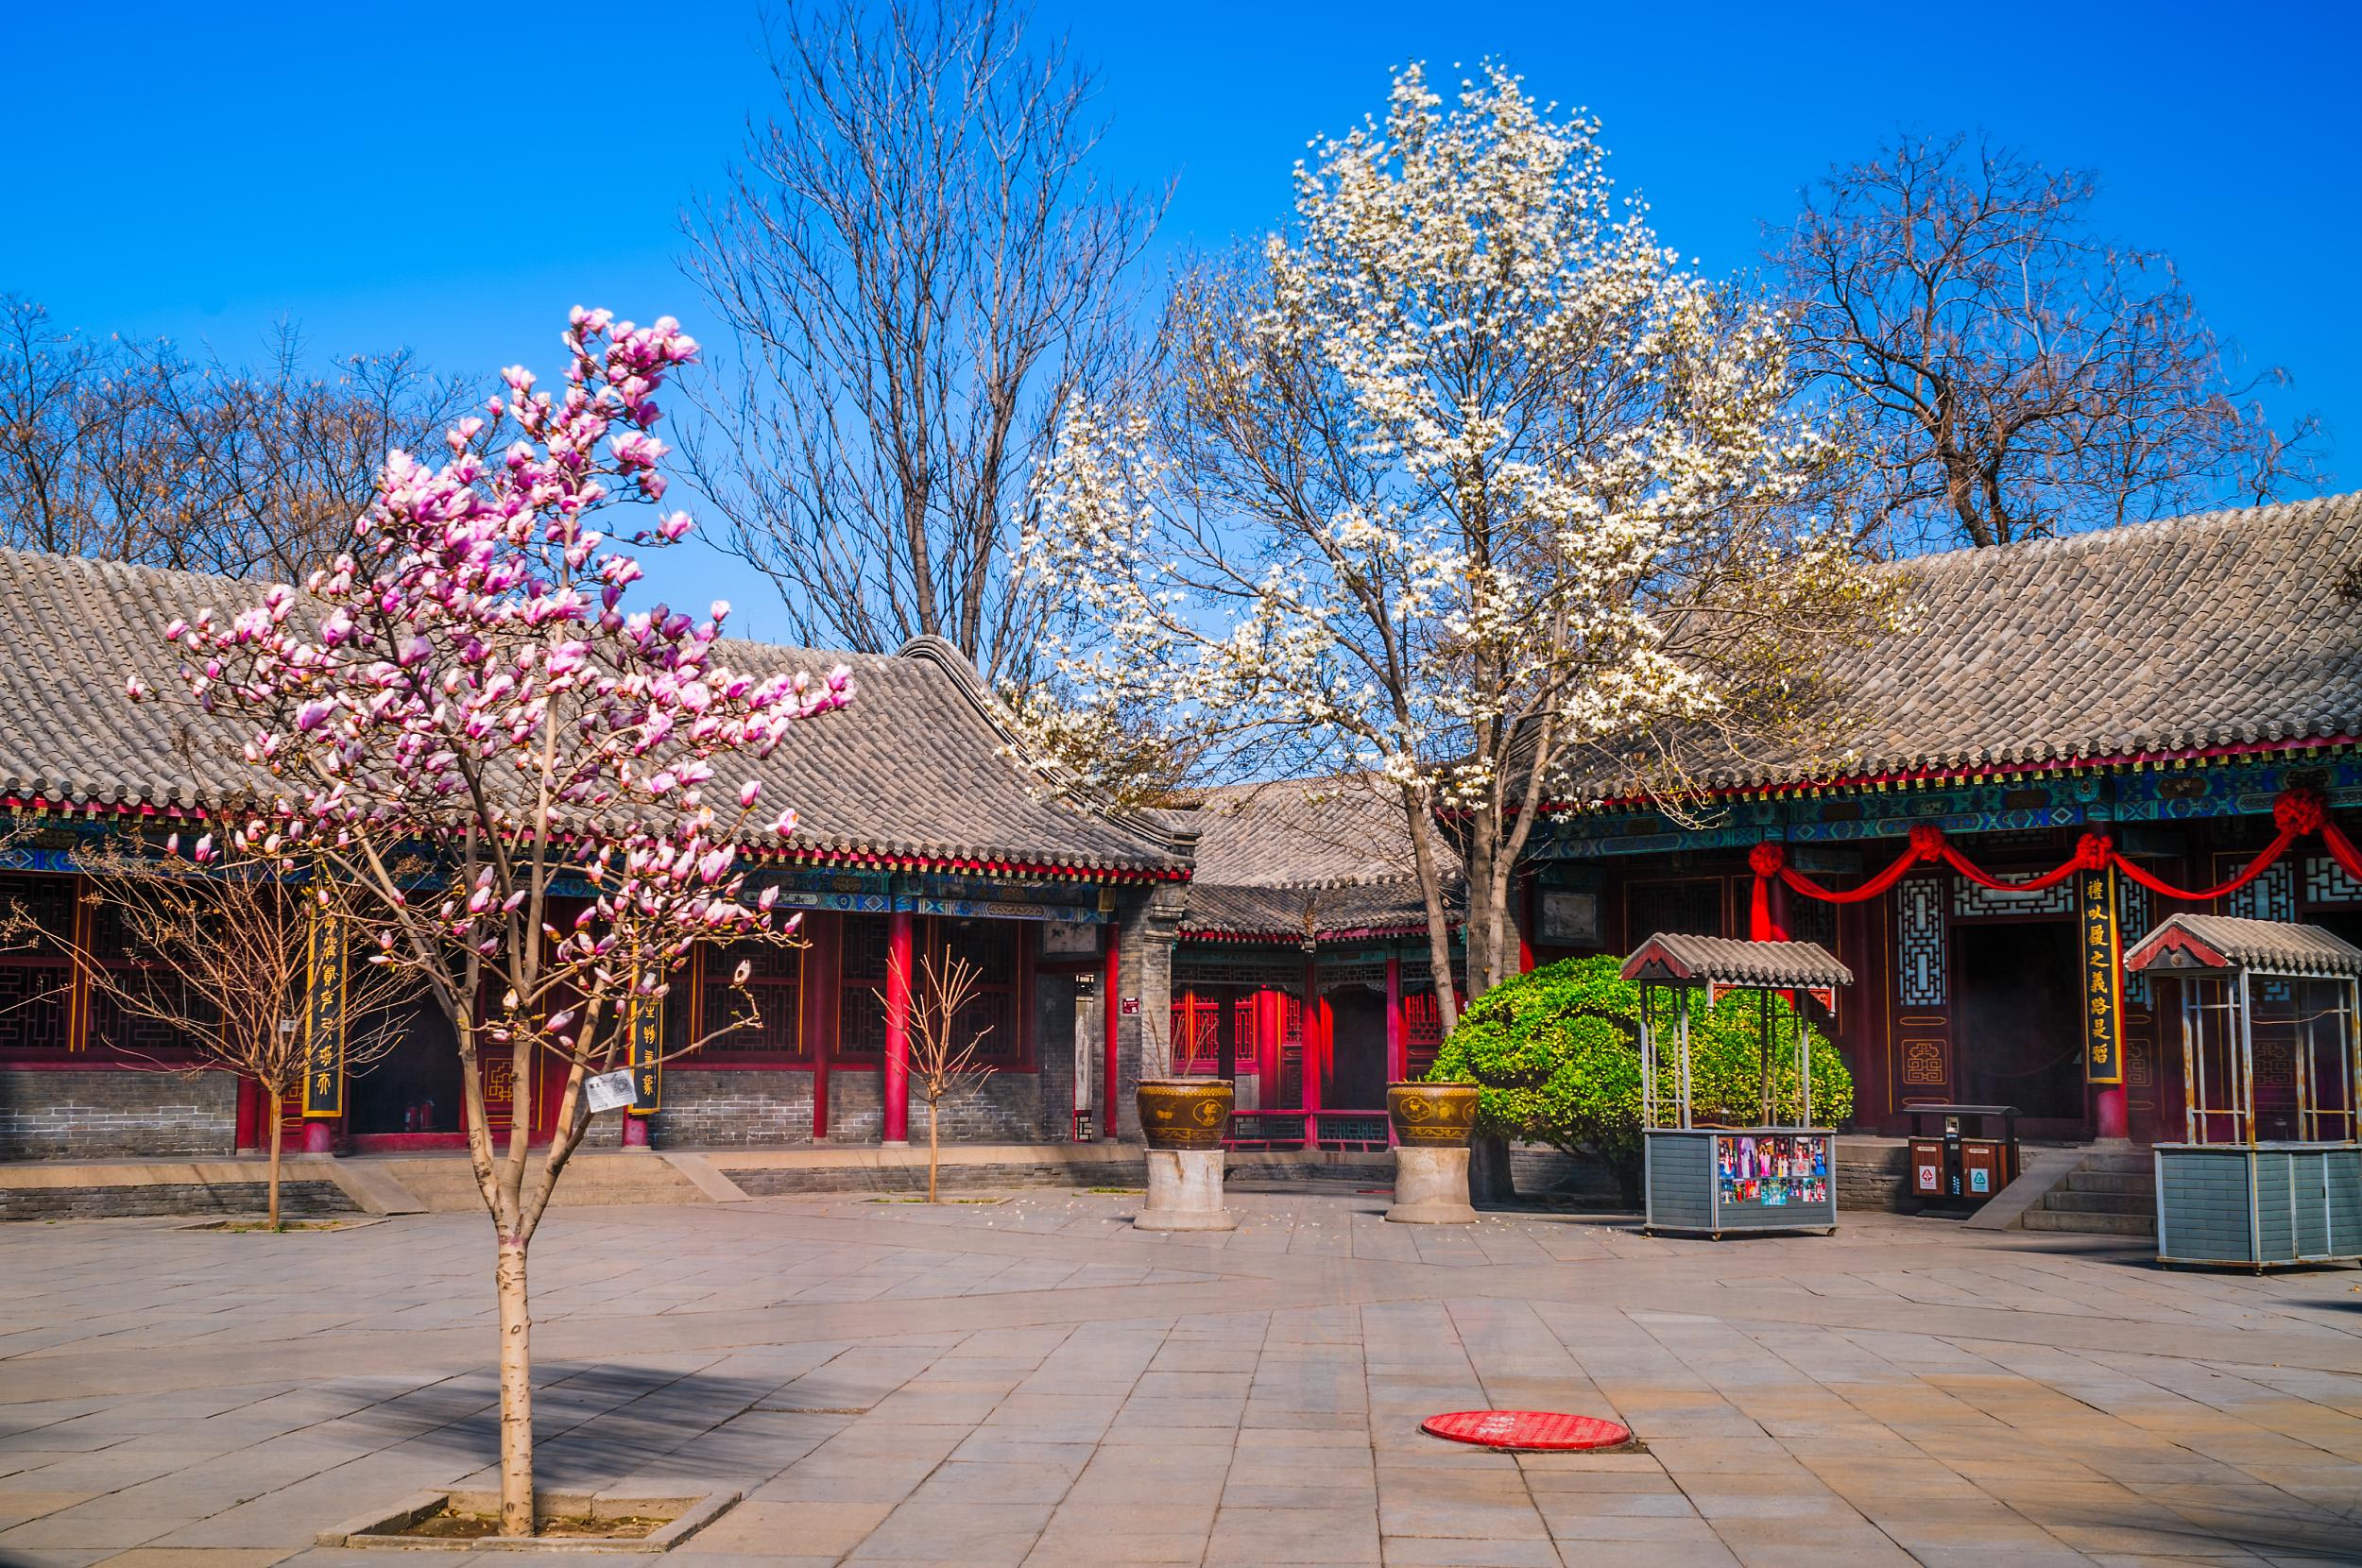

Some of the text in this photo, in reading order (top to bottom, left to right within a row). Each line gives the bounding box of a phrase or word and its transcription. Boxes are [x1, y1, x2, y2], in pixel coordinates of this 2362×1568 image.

[2086, 878, 2112, 1064] 禮以履之義路是蹈
